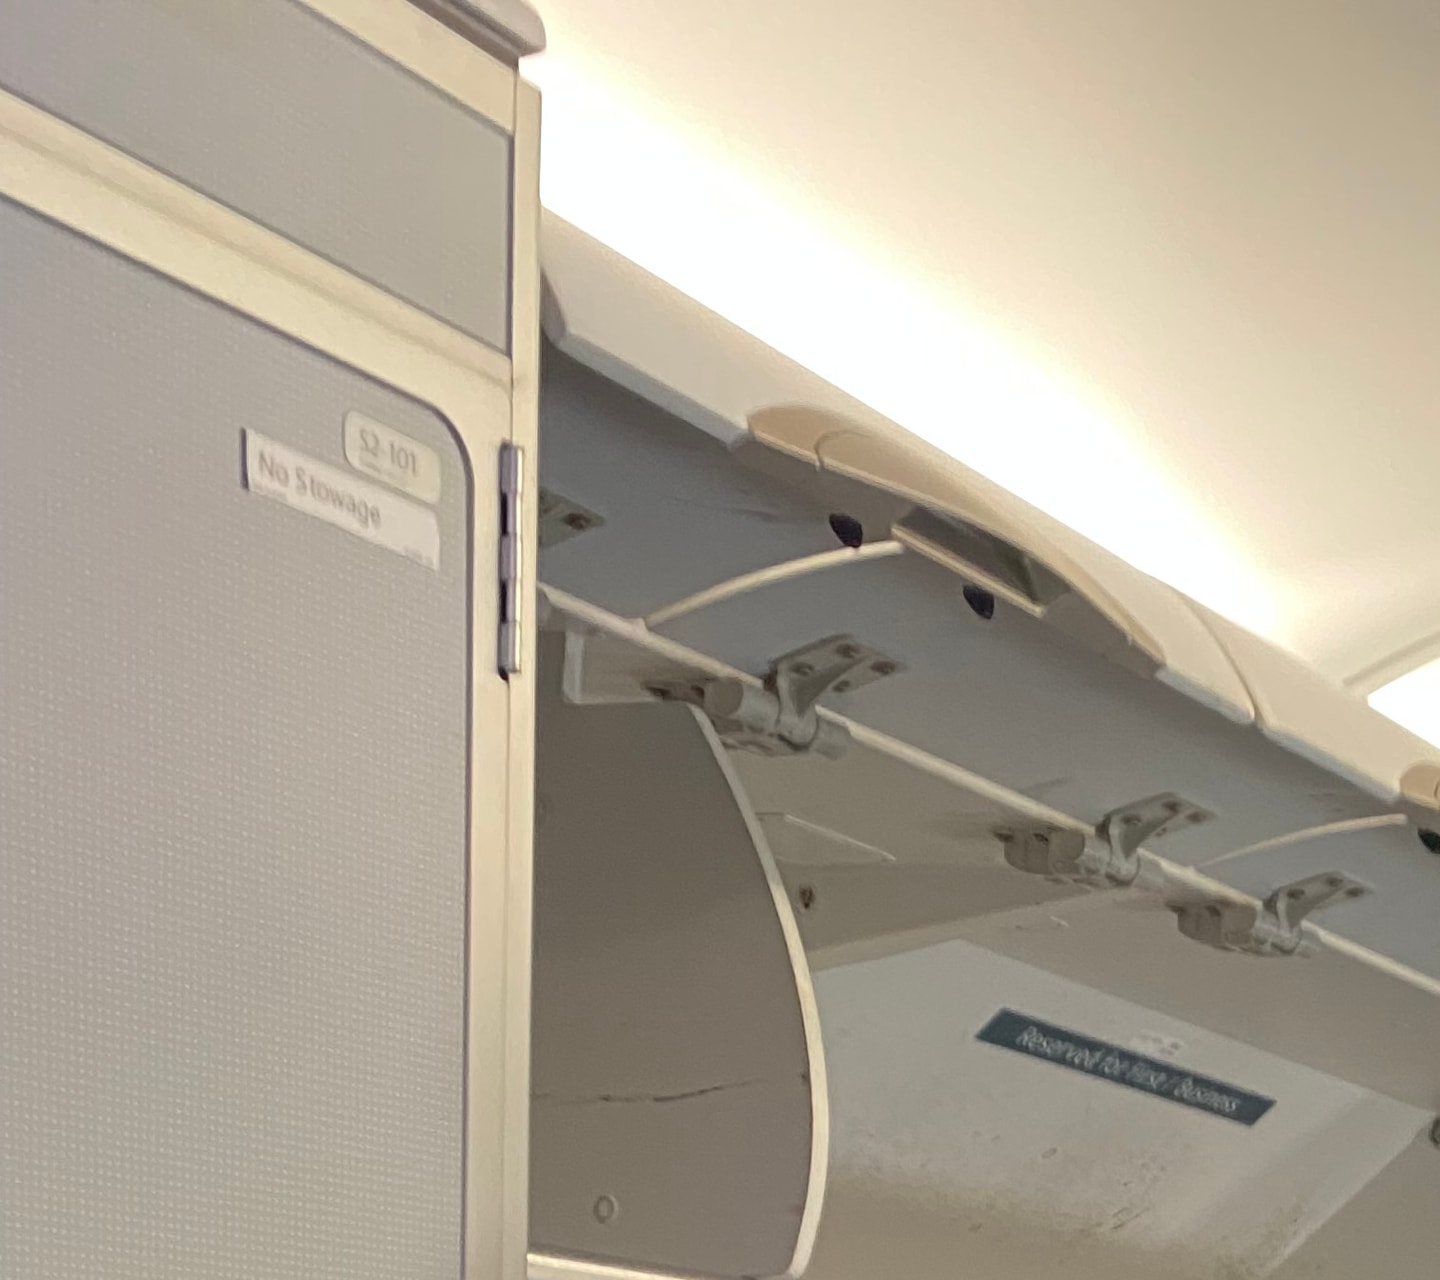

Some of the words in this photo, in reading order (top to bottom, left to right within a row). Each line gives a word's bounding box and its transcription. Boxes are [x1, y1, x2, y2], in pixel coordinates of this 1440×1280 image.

[258, 451, 290, 488] No
[295, 465, 382, 530] Stowage
[1016, 1025, 1102, 1070] Reserved
